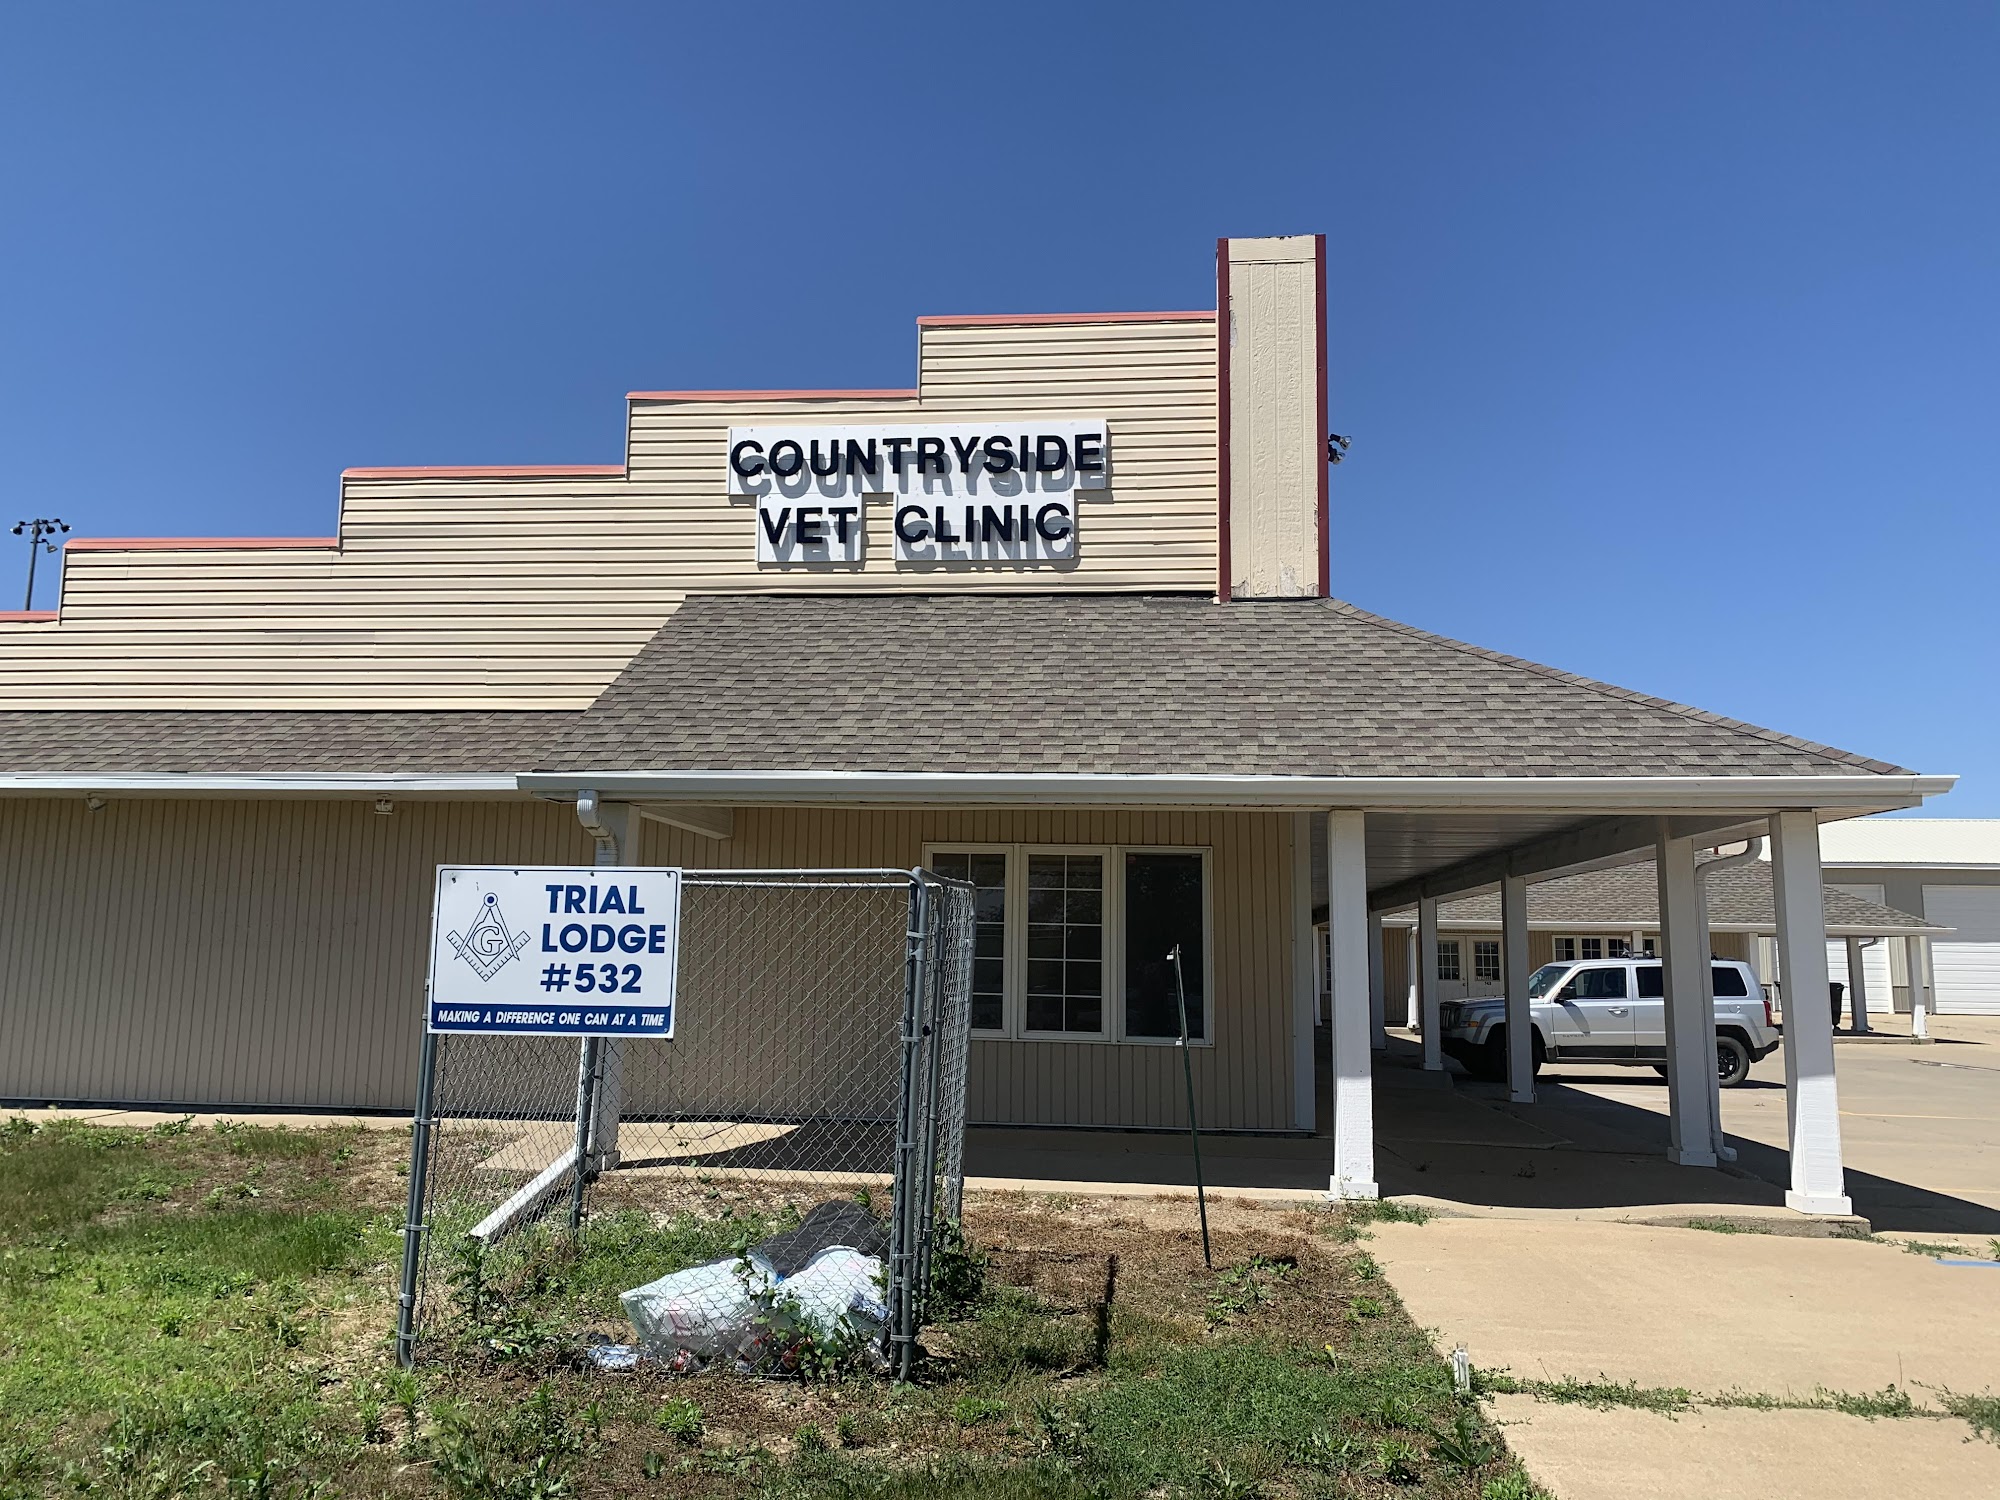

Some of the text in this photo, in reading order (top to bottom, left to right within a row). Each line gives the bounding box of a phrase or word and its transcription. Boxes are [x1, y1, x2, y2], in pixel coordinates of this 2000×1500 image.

[731, 433, 1102, 476] COUNTRYSIDE
[760, 503, 1070, 544] VET CLINIC
[545, 885, 645, 914] TRIAL
[472, 926, 503, 956] G
[541, 923, 666, 954] LODGE
[540, 963, 642, 993] #532
[438, 1010, 665, 1026] MAKING A DIFFERENCE ONE CAN AT A TIME
